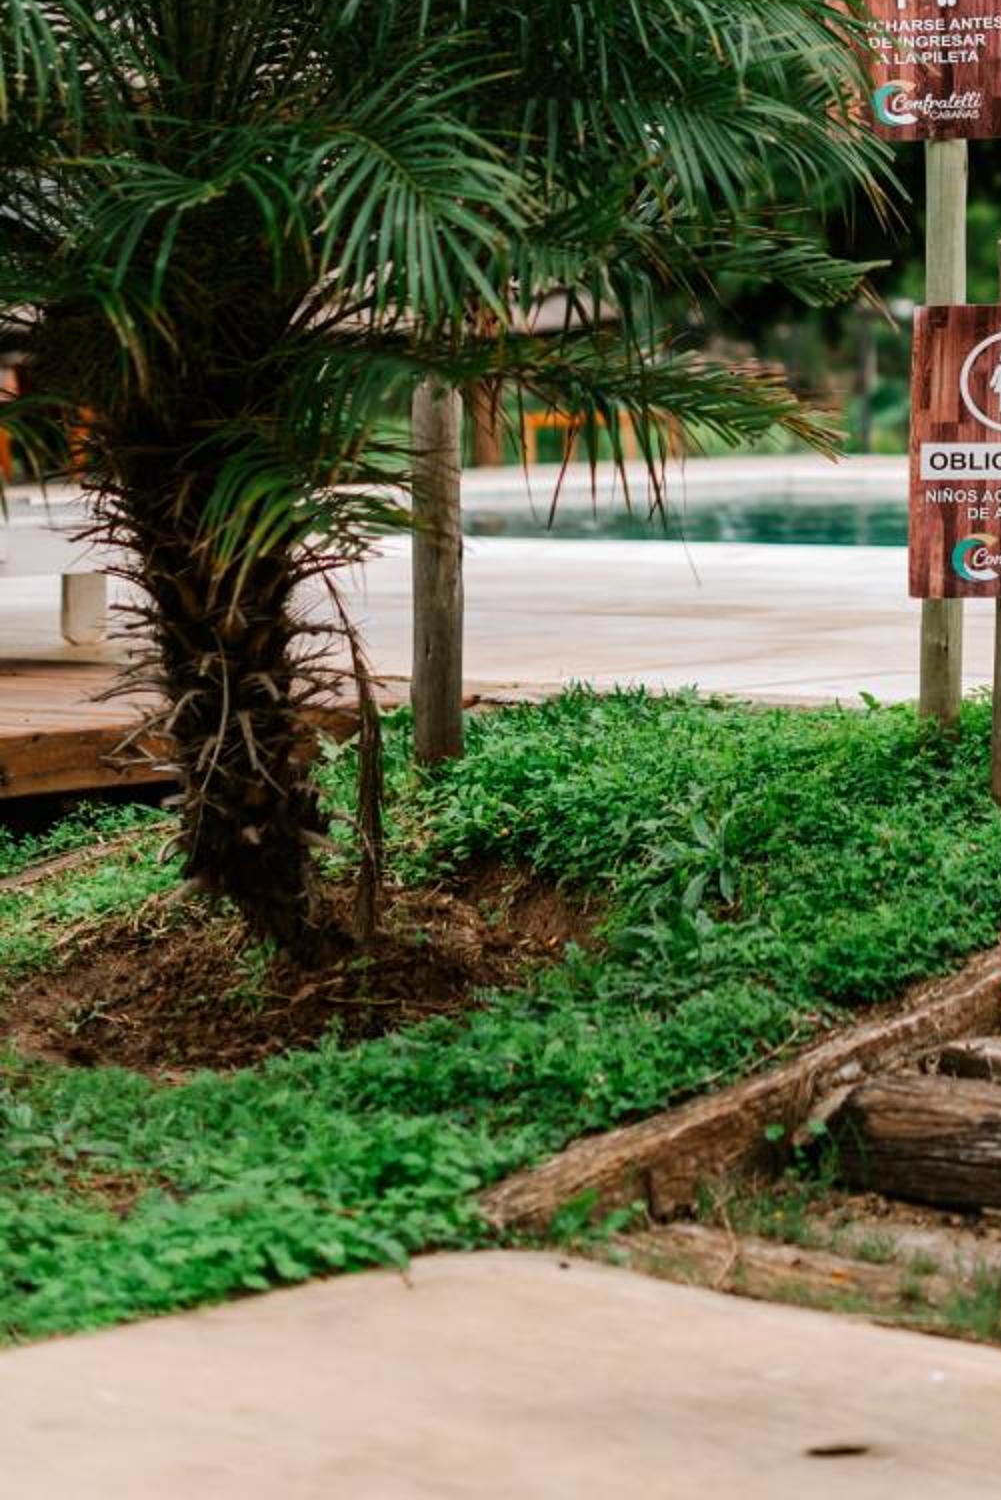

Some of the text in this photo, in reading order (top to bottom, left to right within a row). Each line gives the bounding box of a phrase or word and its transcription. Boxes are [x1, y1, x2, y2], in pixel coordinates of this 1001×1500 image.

[863, 18, 945, 32] CHARSE
[868, 36, 893, 49] DE
[894, 51, 917, 65] LA
[921, 50, 979, 64] PILETA
[891, 92, 982, 115] Confratelli
[926, 488, 977, 503] NIÑOS
[967, 507, 989, 519] DE
